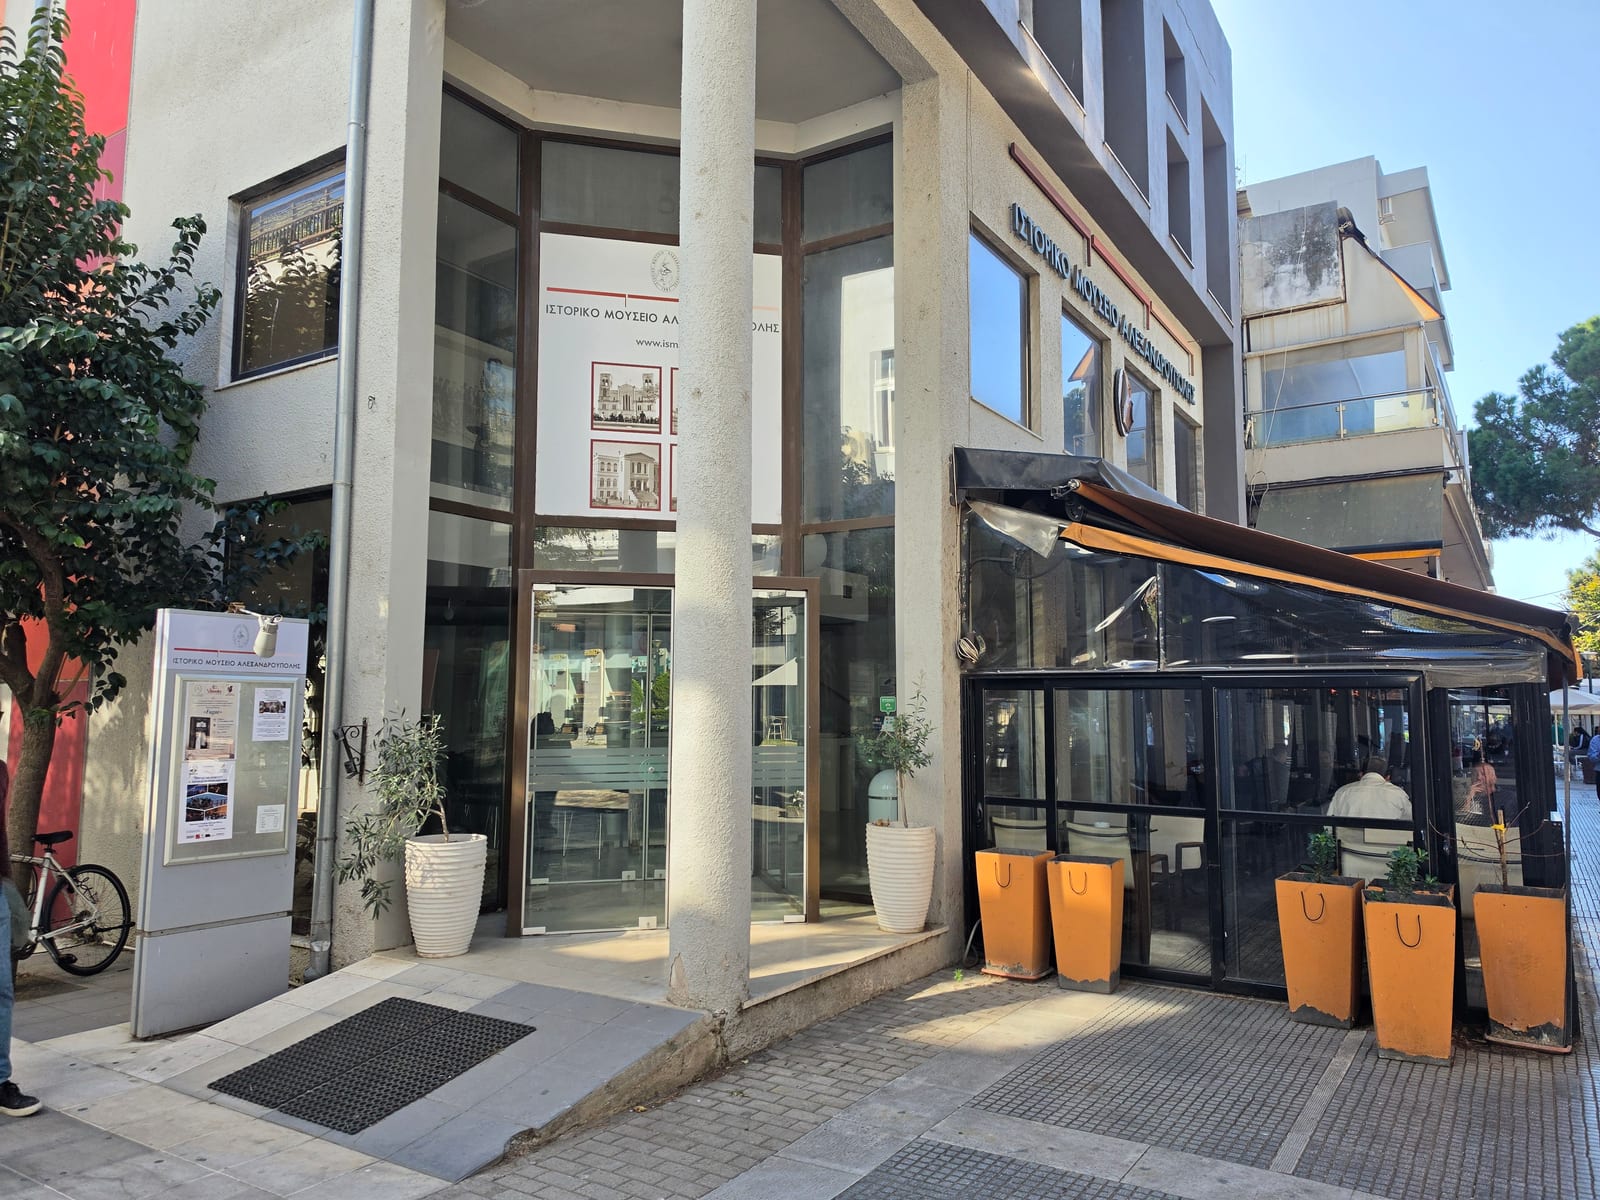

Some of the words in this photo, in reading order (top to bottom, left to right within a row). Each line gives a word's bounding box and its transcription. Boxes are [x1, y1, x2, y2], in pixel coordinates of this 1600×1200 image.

[1011, 202, 1071, 279] ΙΣΤΟΡΙΚΟ
[1072, 264, 1120, 327] ΜΟΥΣΕΙΟ
[545, 304, 600, 318] ΙΣΤΟΡΙΚΟ
[604, 309, 658, 323] ΜΟΥΣΕΙΟ
[172, 657, 204, 665] ΙΣΤΟΡΙΚΟ
[206, 659, 236, 667] ΜΟΥΣΕΙΟ
